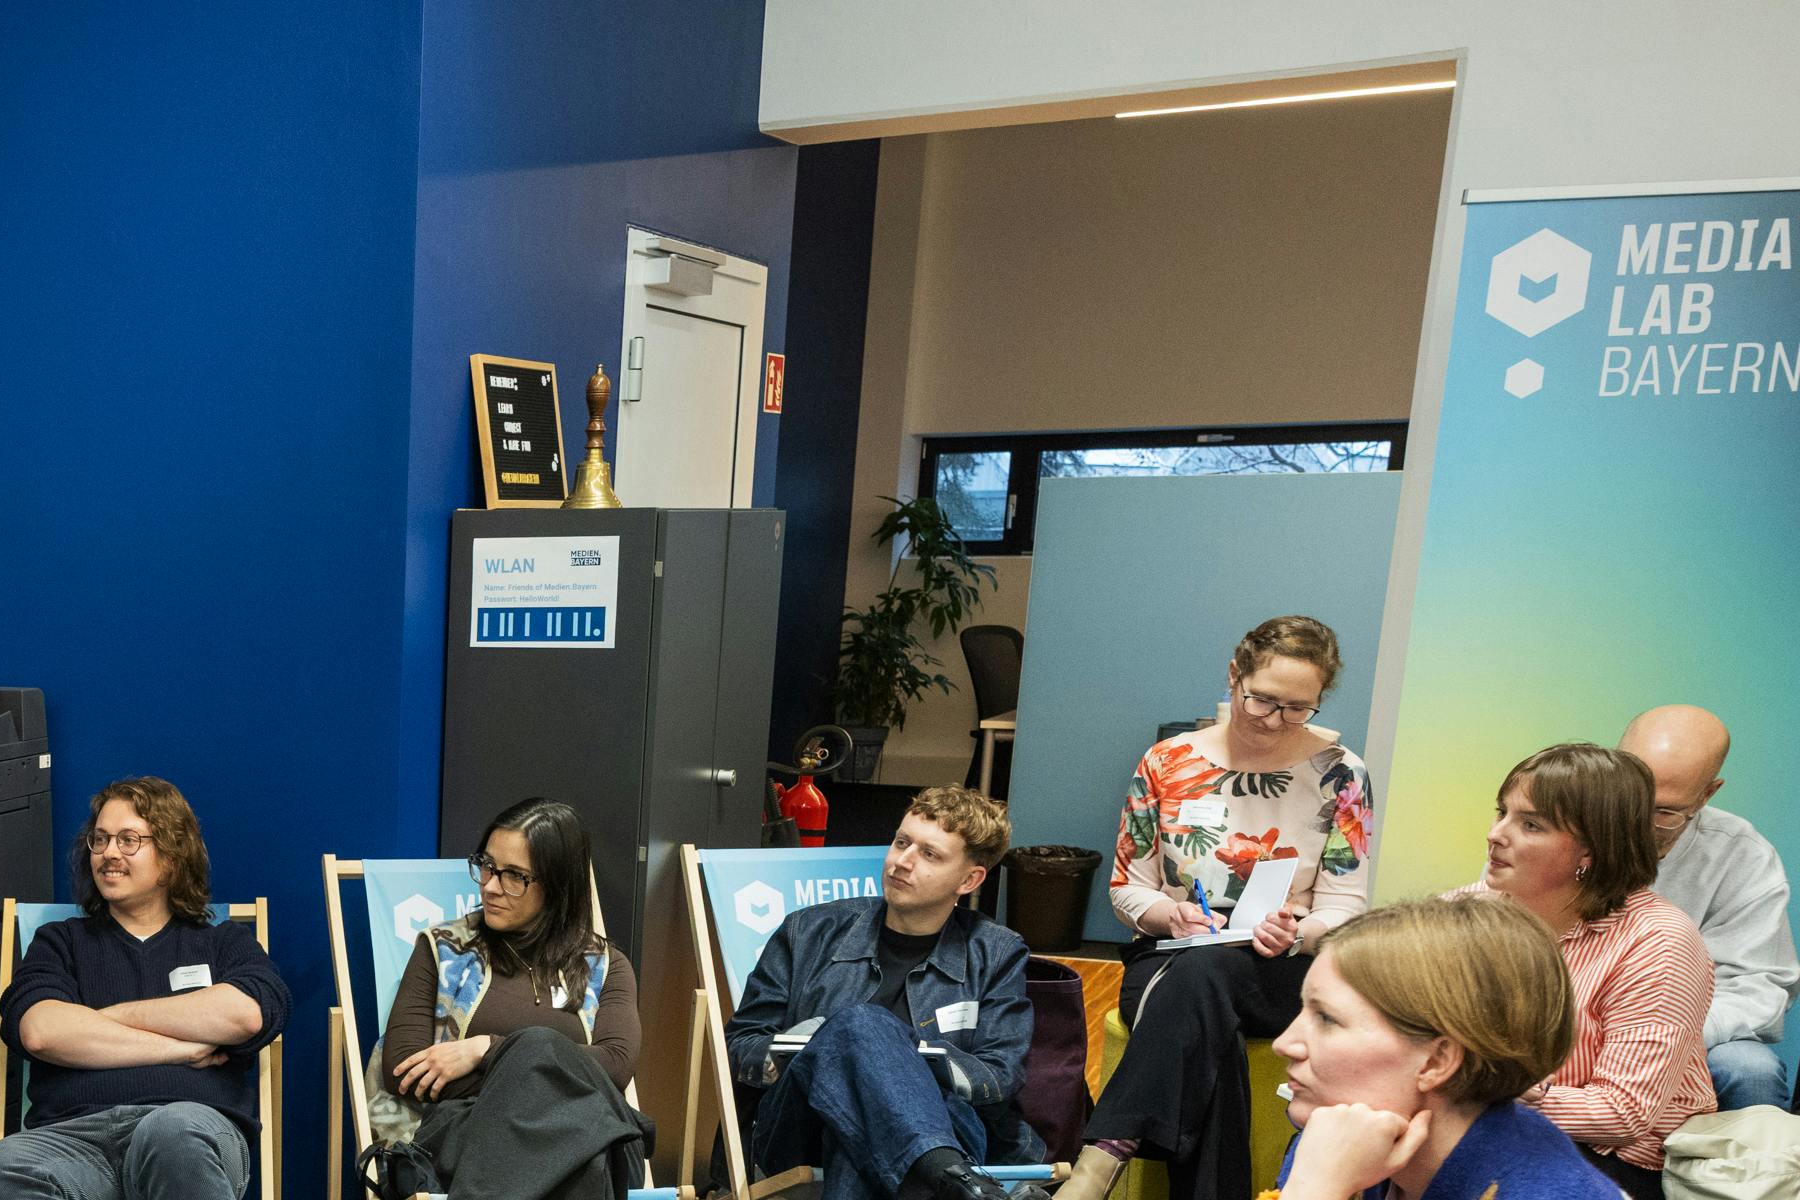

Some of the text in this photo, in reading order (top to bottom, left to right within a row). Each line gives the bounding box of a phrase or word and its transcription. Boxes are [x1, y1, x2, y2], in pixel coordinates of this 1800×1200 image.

[1615, 217, 1792, 277] MEDIA
[1607, 282, 1715, 337] LAB
[1598, 341, 1800, 397] BAYERN
[485, 558, 535, 574] WLAN
[570, 557, 600, 566] BAYERN
[483, 584, 505, 592] Name:
[508, 583, 533, 591] Friends
[535, 583, 542, 591] of
[794, 876, 878, 906] MEDIA
